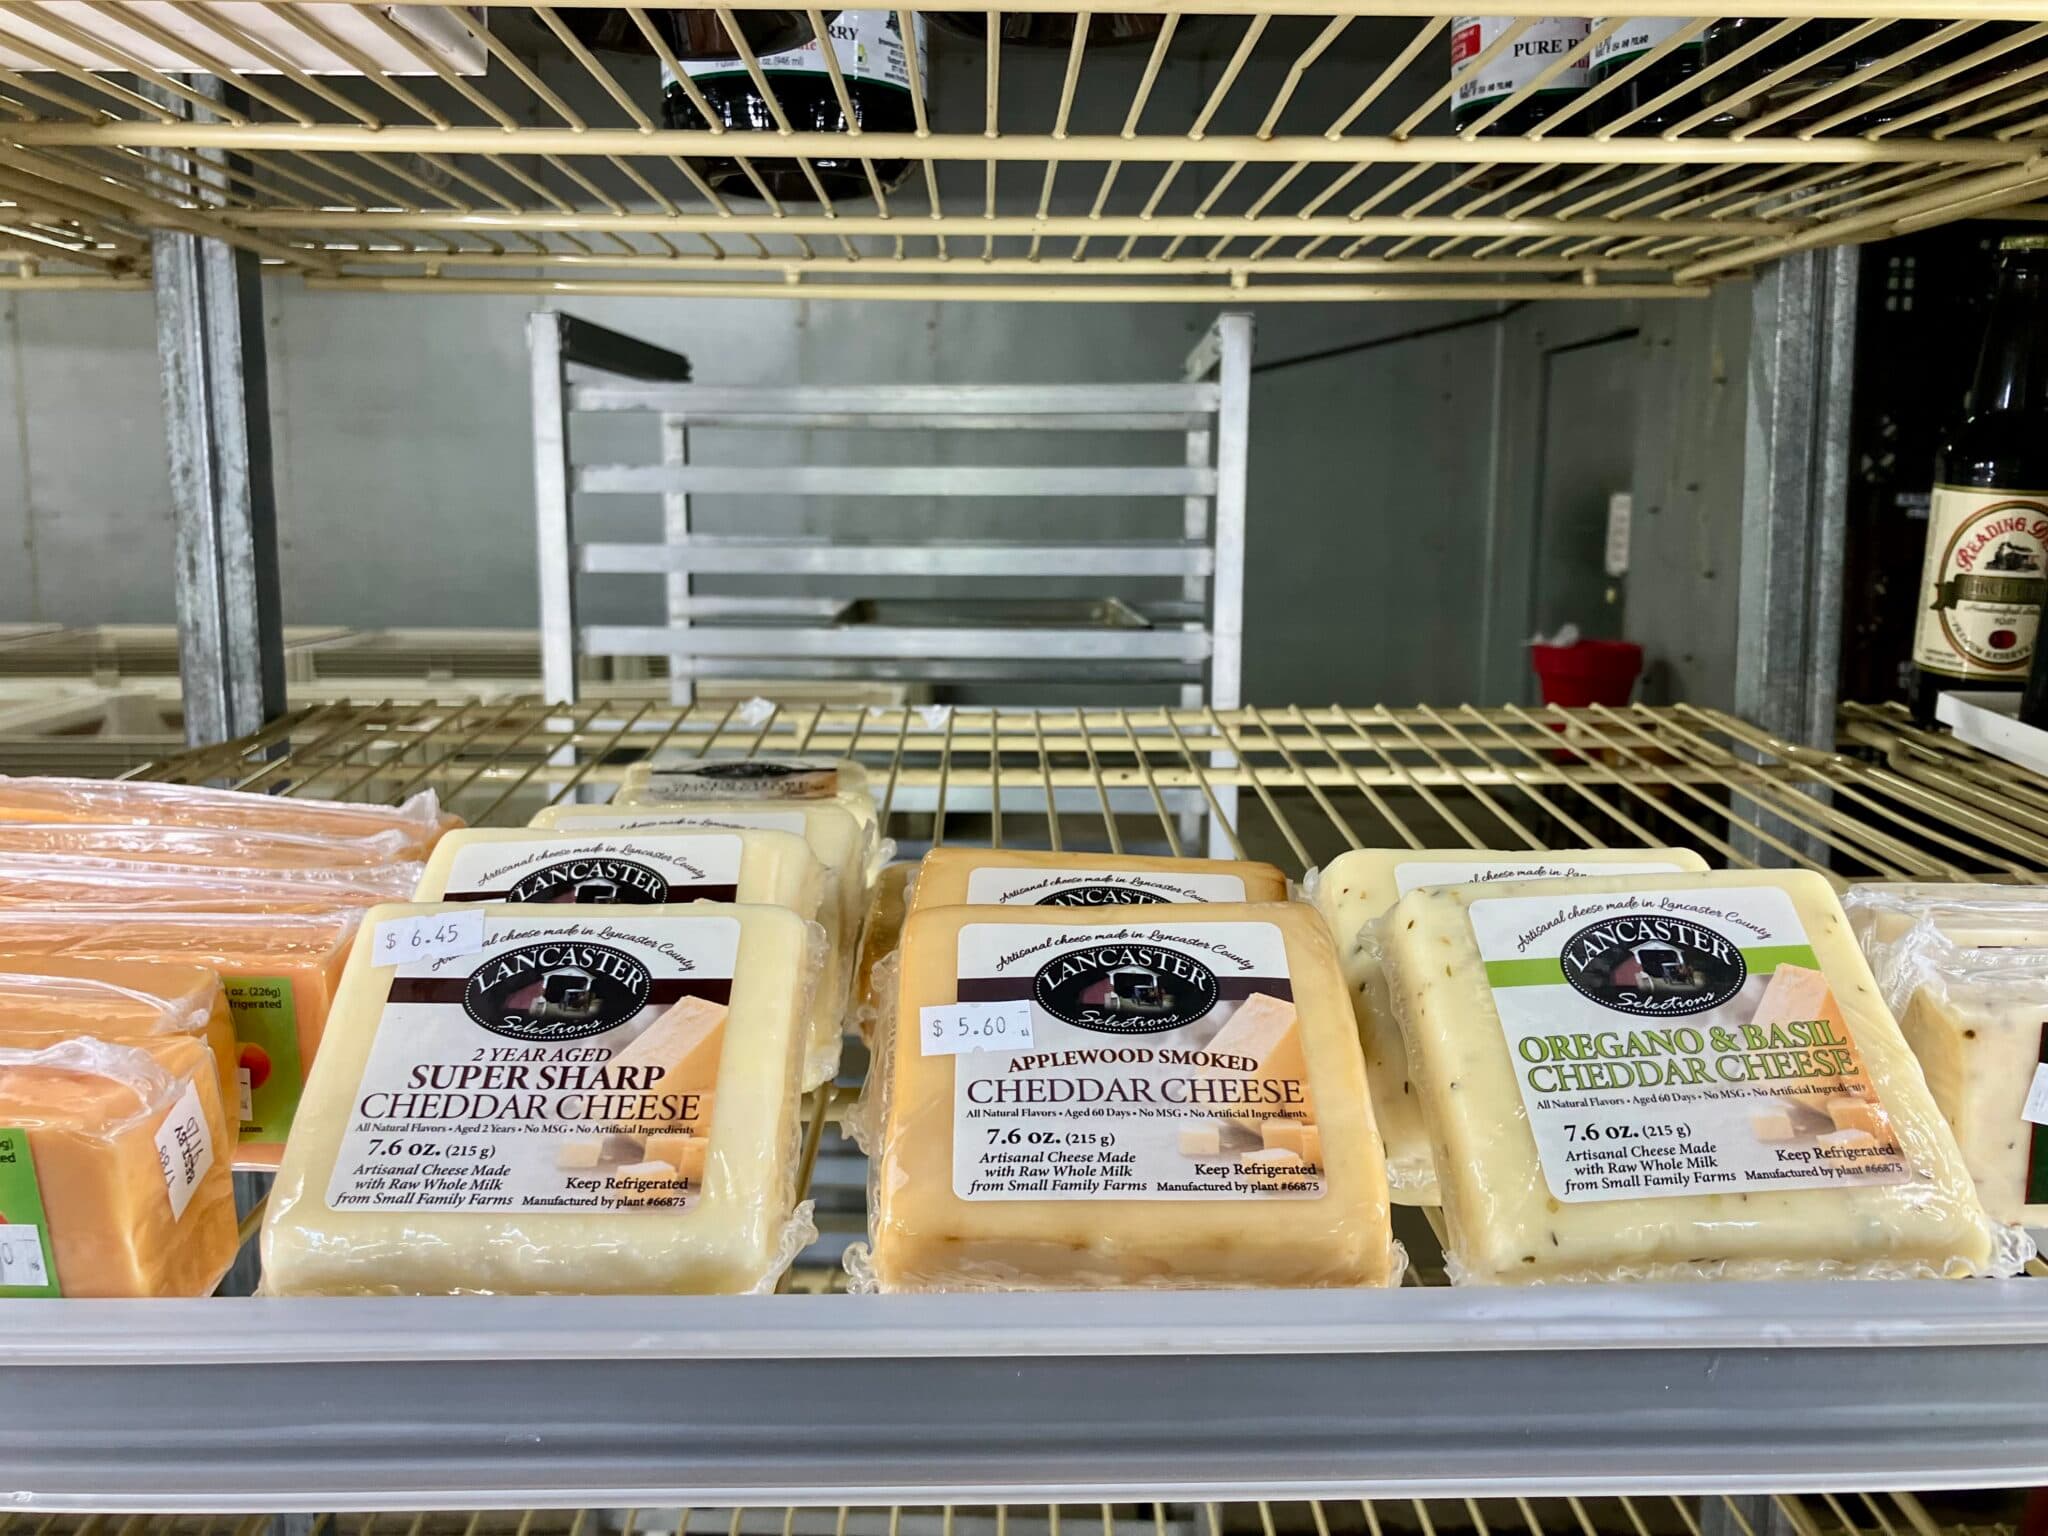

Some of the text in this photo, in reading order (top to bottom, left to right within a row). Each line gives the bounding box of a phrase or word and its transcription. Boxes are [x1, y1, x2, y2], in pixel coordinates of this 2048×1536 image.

[1513, 39, 1562, 57] PURE
[1956, 517, 2027, 572] READING
[478, 842, 672, 887] Artisanal cheese made Lancaster
[1517, 866, 1547, 876] made
[517, 861, 663, 902] LANCASTER
[1085, 874, 1182, 895] made Lancaster
[1517, 896, 1773, 953] Artisanal cheese made in Lancaster County
[386, 932, 397, 950] $
[411, 924, 460, 948] 6.45
[1567, 920, 1732, 973] LANCASTER
[500, 928, 541, 944] cheese
[544, 924, 579, 936] made
[580, 925, 594, 935] in
[597, 926, 659, 948] Lancaster
[657, 943, 697, 972] County
[996, 928, 1255, 972] Artisanal cheese made in Lancaster County
[474, 946, 645, 995] LANCASTER
[1042, 949, 1208, 992] LANCASTER
[250, 987, 281, 998] (226g)
[1615, 991, 1716, 1010] Selections
[229, 1000, 282, 1010] frigerated
[497, 1015, 602, 1036] Selections
[933, 1019, 943, 1037] $
[959, 1016, 1006, 1036] 5.60
[1078, 1009, 1180, 1029] Selections
[1518, 1019, 1848, 1063] OREGANO & BASIL
[472, 1048, 613, 1062] 2 YEAR AGED
[1008, 1048, 1259, 1073] APPLEWOOD SMOKED
[407, 1065, 666, 1091] SUPER SHARP
[1527, 1048, 1860, 1093] CHEDDAR CHEESE
[966, 1078, 1306, 1105] CHEDDAR CHEESE
[1552, 1082, 1866, 1109] Natural Flavors Aged 60 Days No MSG No Artificial Ingredients
[360, 1092, 702, 1122] CHEDDAR CHEESE
[966, 1107, 1307, 1121] All Natural Flavors Aged 60 Days No MSG No Artificial Ingredients
[355, 1123, 694, 1137] All Natural Flavors Aged 2 Years No MSG No Artificial Ingredients
[986, 1128, 1116, 1147] 7.6 oz. (215 g)
[1564, 1122, 1691, 1143] 7.6 oz. (215 g)
[368, 1139, 496, 1160] 7.6 oz. (215 g)
[979, 1150, 1136, 1164] Artisanal Cheese Made
[1566, 1142, 1717, 1162] Artisanal Cheese Made
[1775, 1142, 1897, 1164] Keep Refrigerated
[353, 1164, 511, 1176] Artisanal Cheese Made
[985, 1164, 1133, 1178] with Raw Whole Milk
[1195, 1163, 1317, 1179] Keep Refrigerated
[1575, 1155, 1718, 1175] with Raw Whole Milk
[1746, 1162, 1903, 1181] Manufactured by plant #66875
[355, 1178, 503, 1191] with Raw Whole Milk
[565, 1177, 689, 1194] Keep Refrigerated
[968, 1179, 1147, 1195] from Small Family Farms
[1156, 1181, 1319, 1194] Manufactured by plant #66875
[1564, 1169, 1737, 1195] from Small Family Farms
[332, 1192, 513, 1208] from Small Family Farms
[522, 1195, 686, 1209] Manufactured by plant #66875
